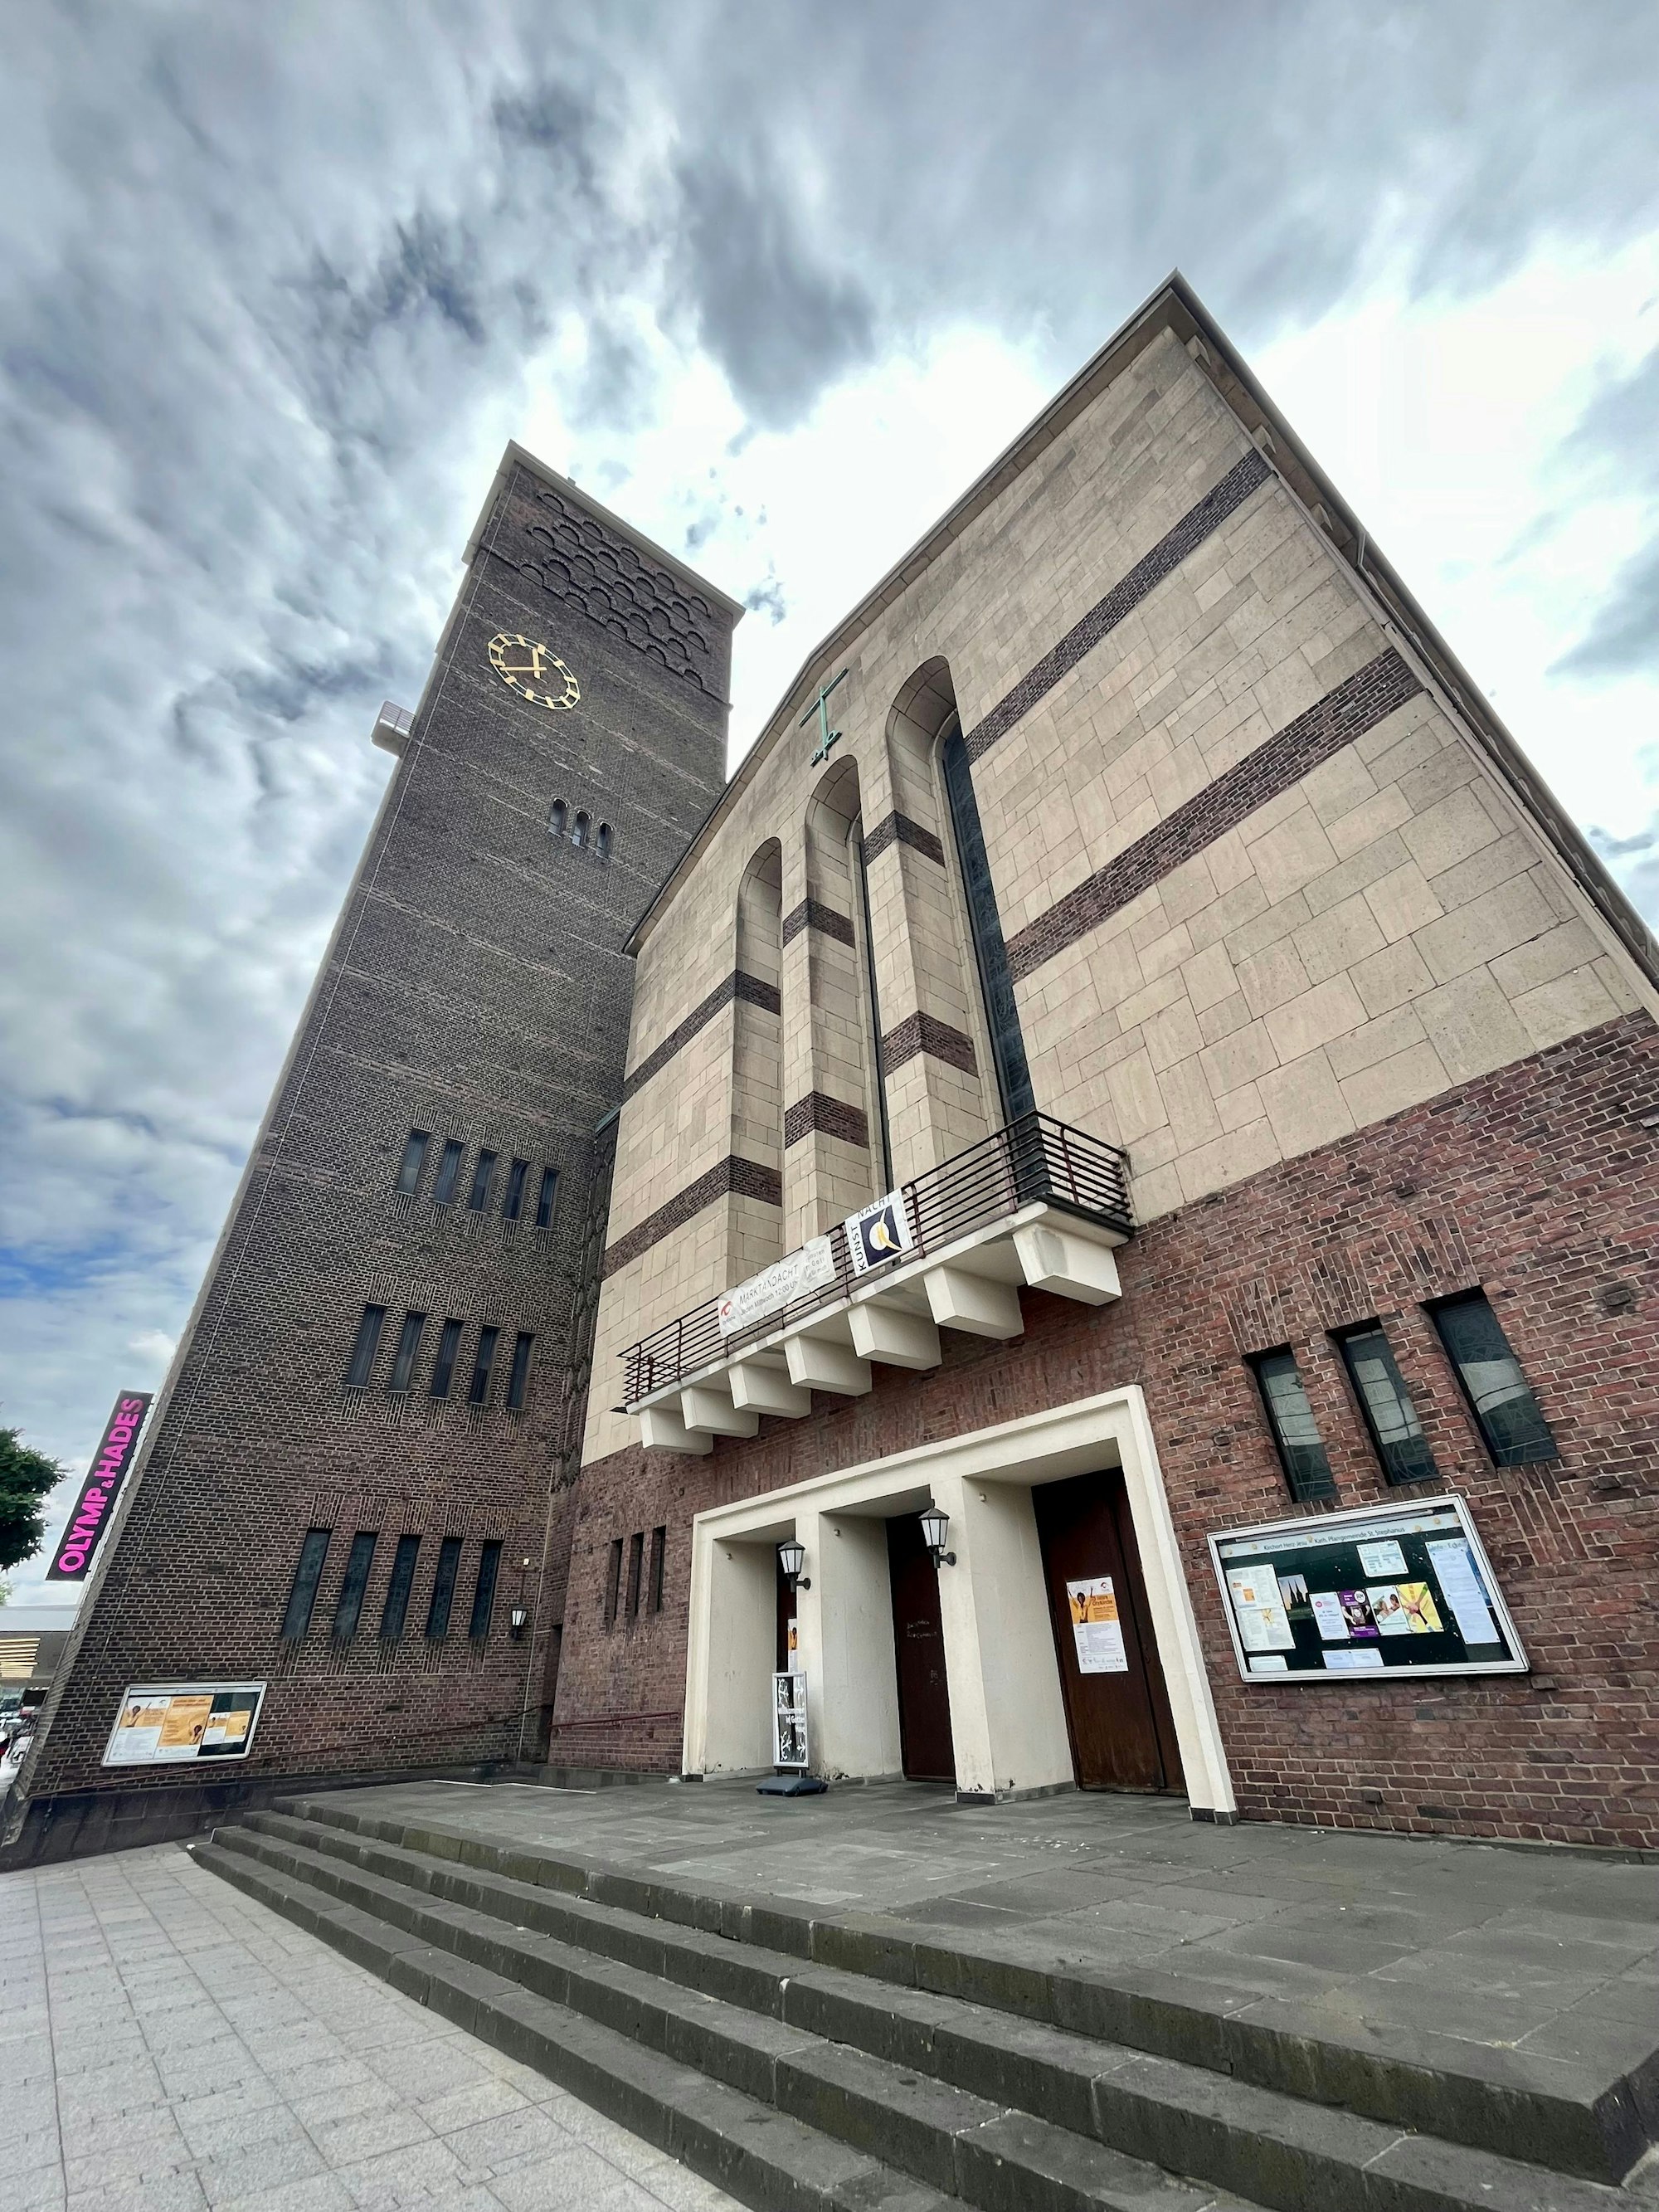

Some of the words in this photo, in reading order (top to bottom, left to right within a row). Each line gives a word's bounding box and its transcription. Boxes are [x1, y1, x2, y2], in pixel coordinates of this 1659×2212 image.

[851, 1226, 867, 1271] KUNST
[739, 1264, 798, 1305] MARKTANDACHT
[775, 1284, 790, 1296] 12:00
[94, 1398, 144, 1478] HADES
[101, 1479, 114, 1488] &
[58, 1487, 109, 1572] OLYMP
[1374, 1527, 1405, 1537] Stephanus
